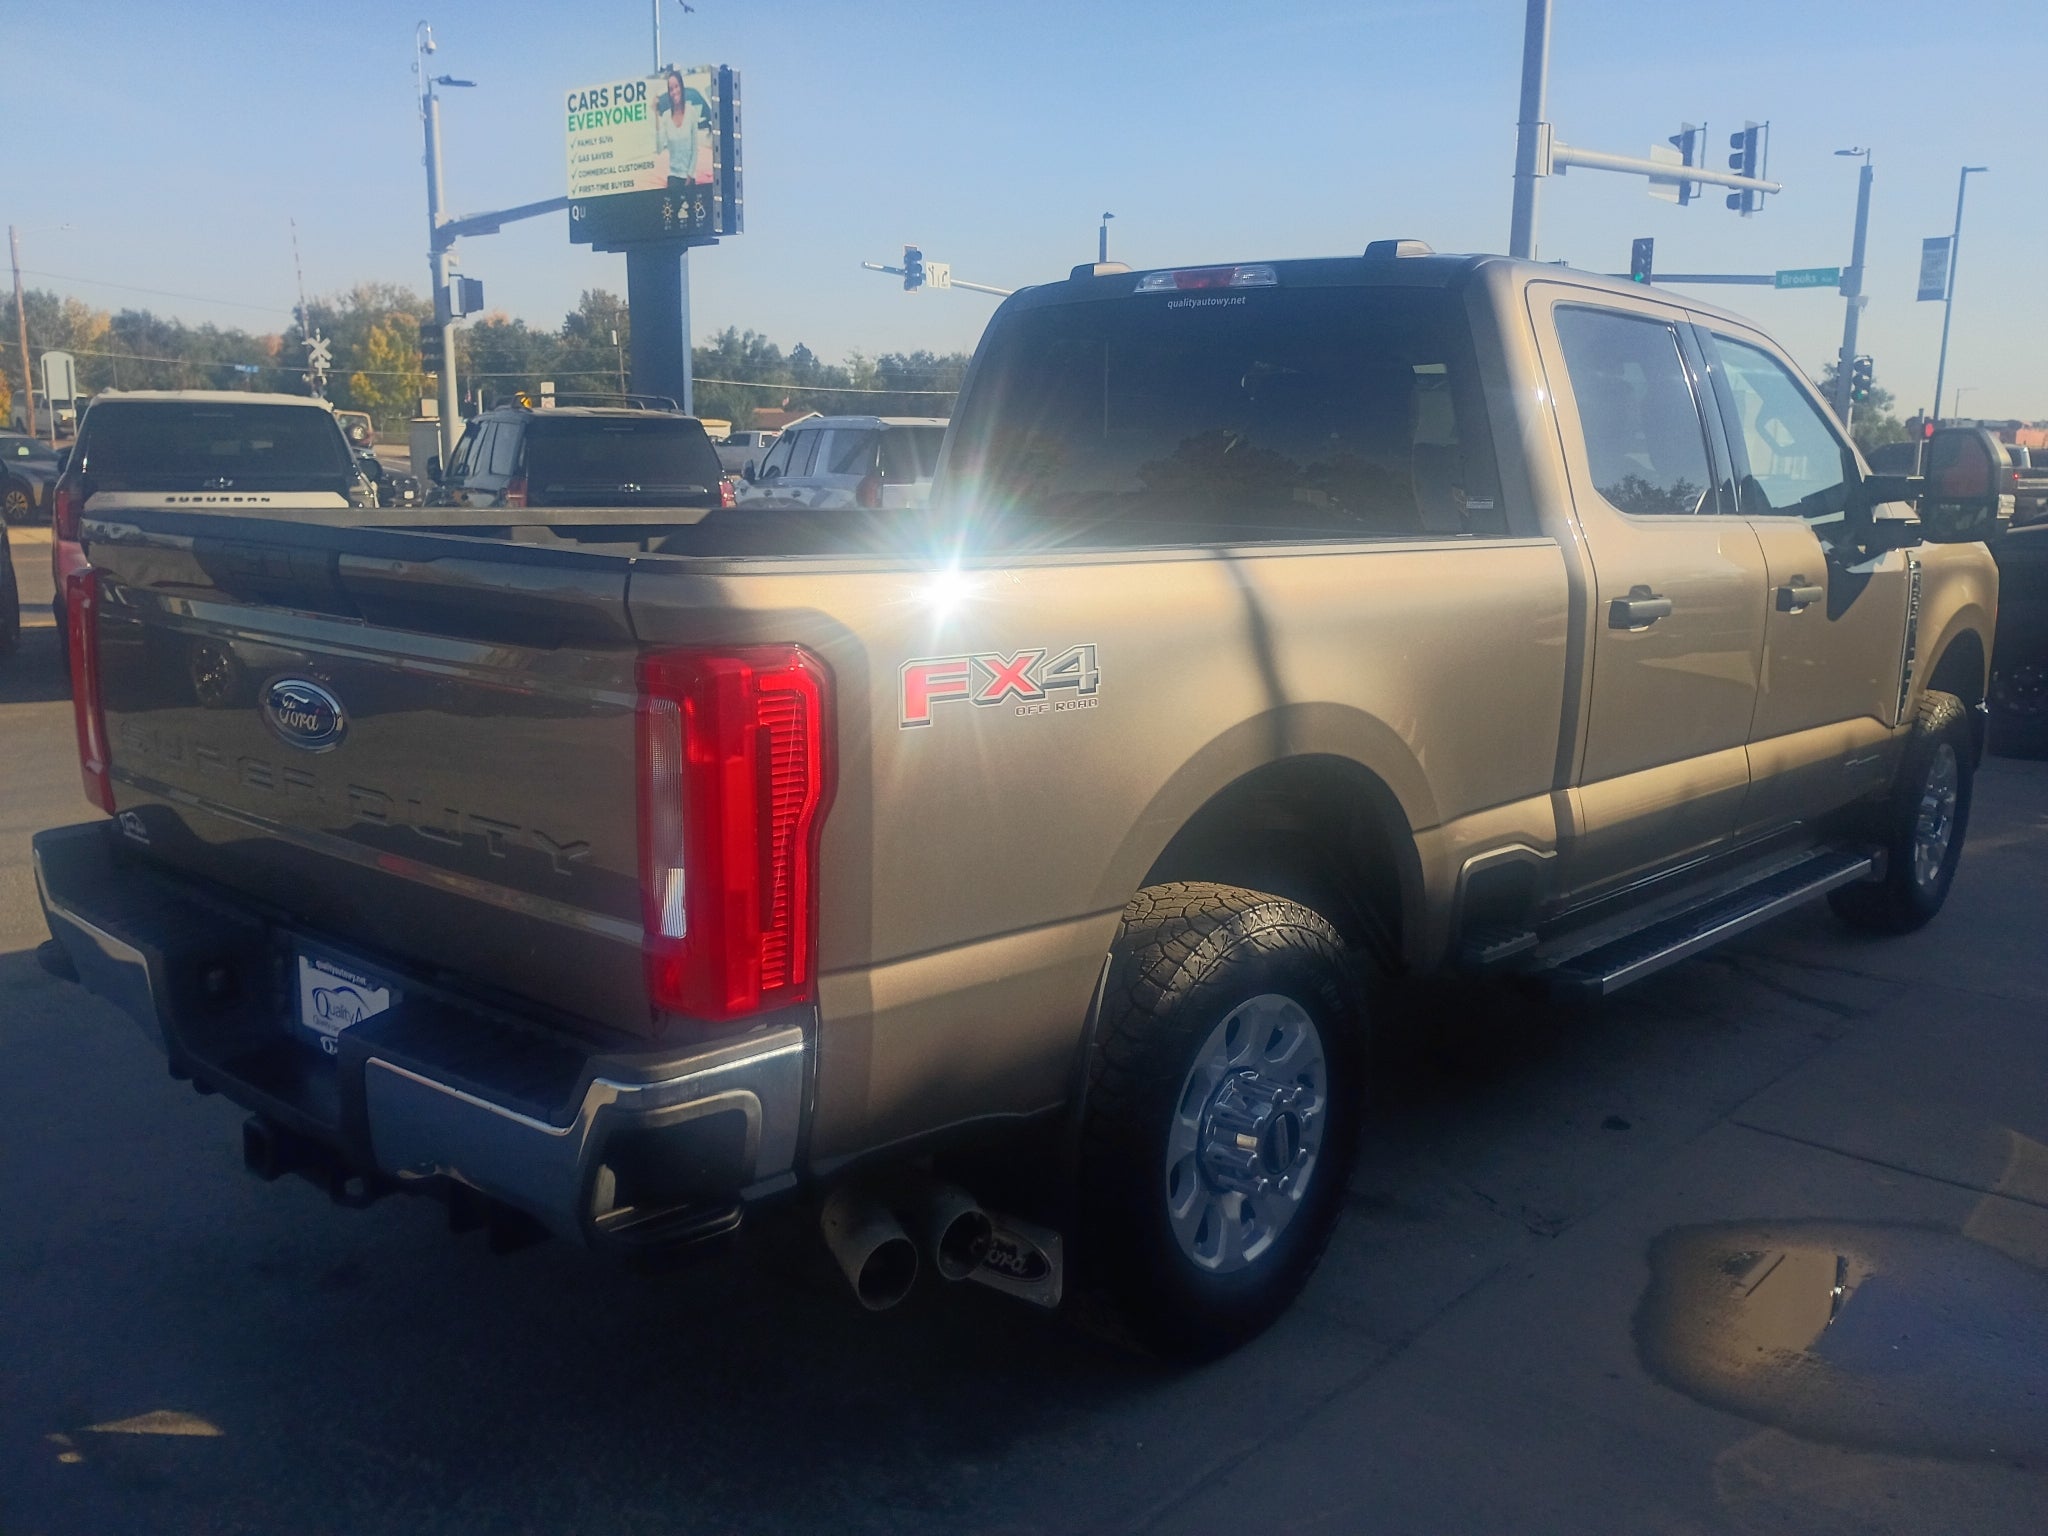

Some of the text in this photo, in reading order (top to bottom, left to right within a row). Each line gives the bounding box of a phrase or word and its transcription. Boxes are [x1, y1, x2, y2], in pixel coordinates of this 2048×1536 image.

[567, 81, 647, 113] CARS FOR
[568, 102, 647, 132] EVERYONE!
[577, 138, 597, 147] FAMILY
[578, 151, 614, 163] GAS SAVERS
[578, 161, 655, 178] COMMERCIAL CUSTOMERS
[579, 180, 635, 193] FIRST-TIME BUYERS
[1781, 273, 1817, 285] Brooks
[1167, 296, 1246, 309] qualityautowy.net
[899, 643, 1102, 730] FX4
[279, 692, 320, 731] Ford
[1014, 698, 1099, 717] OFF ROAD
[119, 719, 590, 876] SUPER DUTY
[315, 989, 353, 1025] Quality
